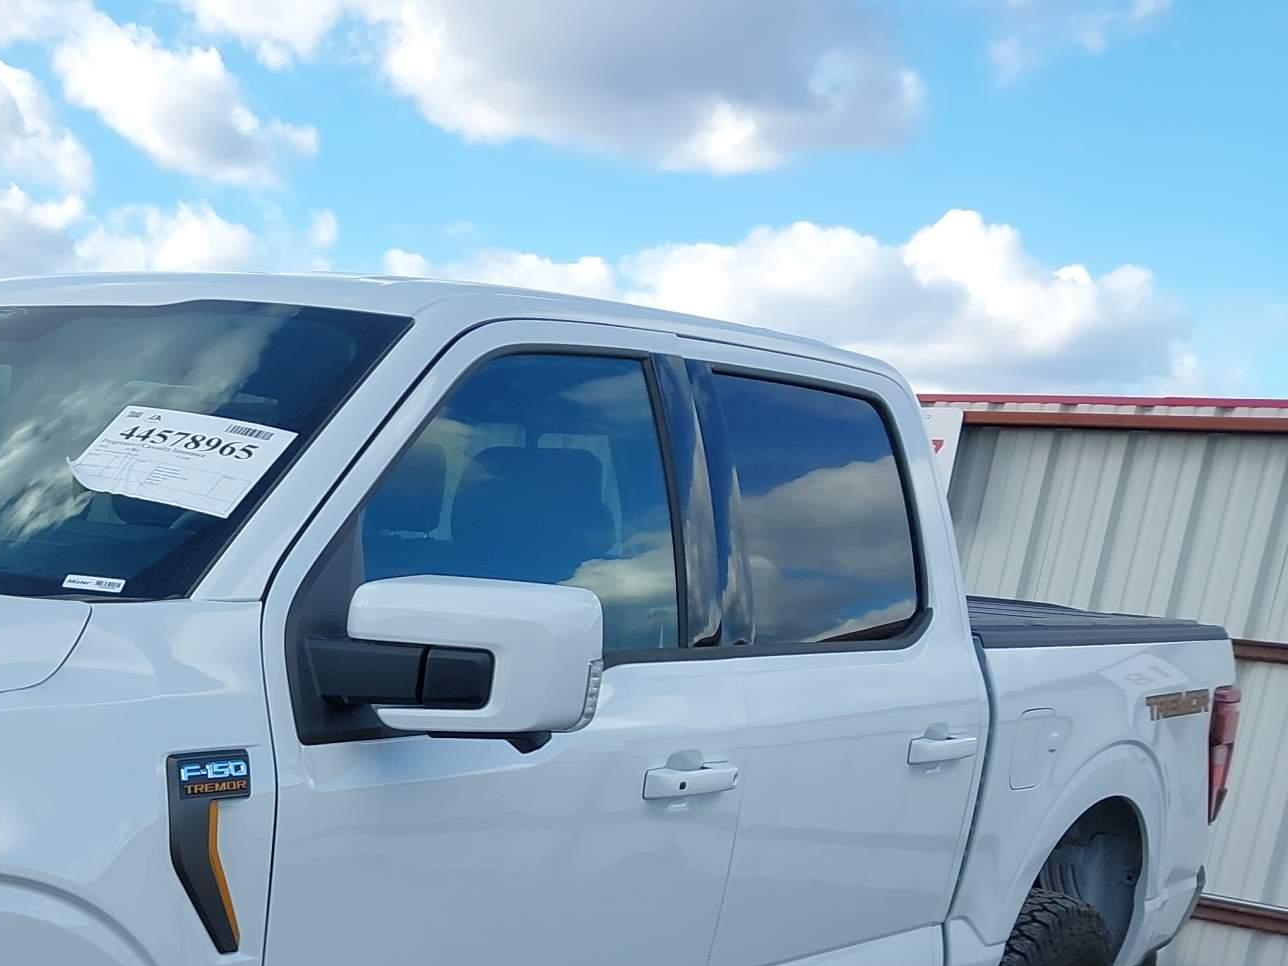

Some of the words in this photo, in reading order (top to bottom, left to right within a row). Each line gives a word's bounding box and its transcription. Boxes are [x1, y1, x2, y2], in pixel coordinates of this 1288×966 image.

[119, 425, 260, 460] 44578965
[180, 759, 248, 781] F-150
[184, 780, 247, 795] TREMOR
